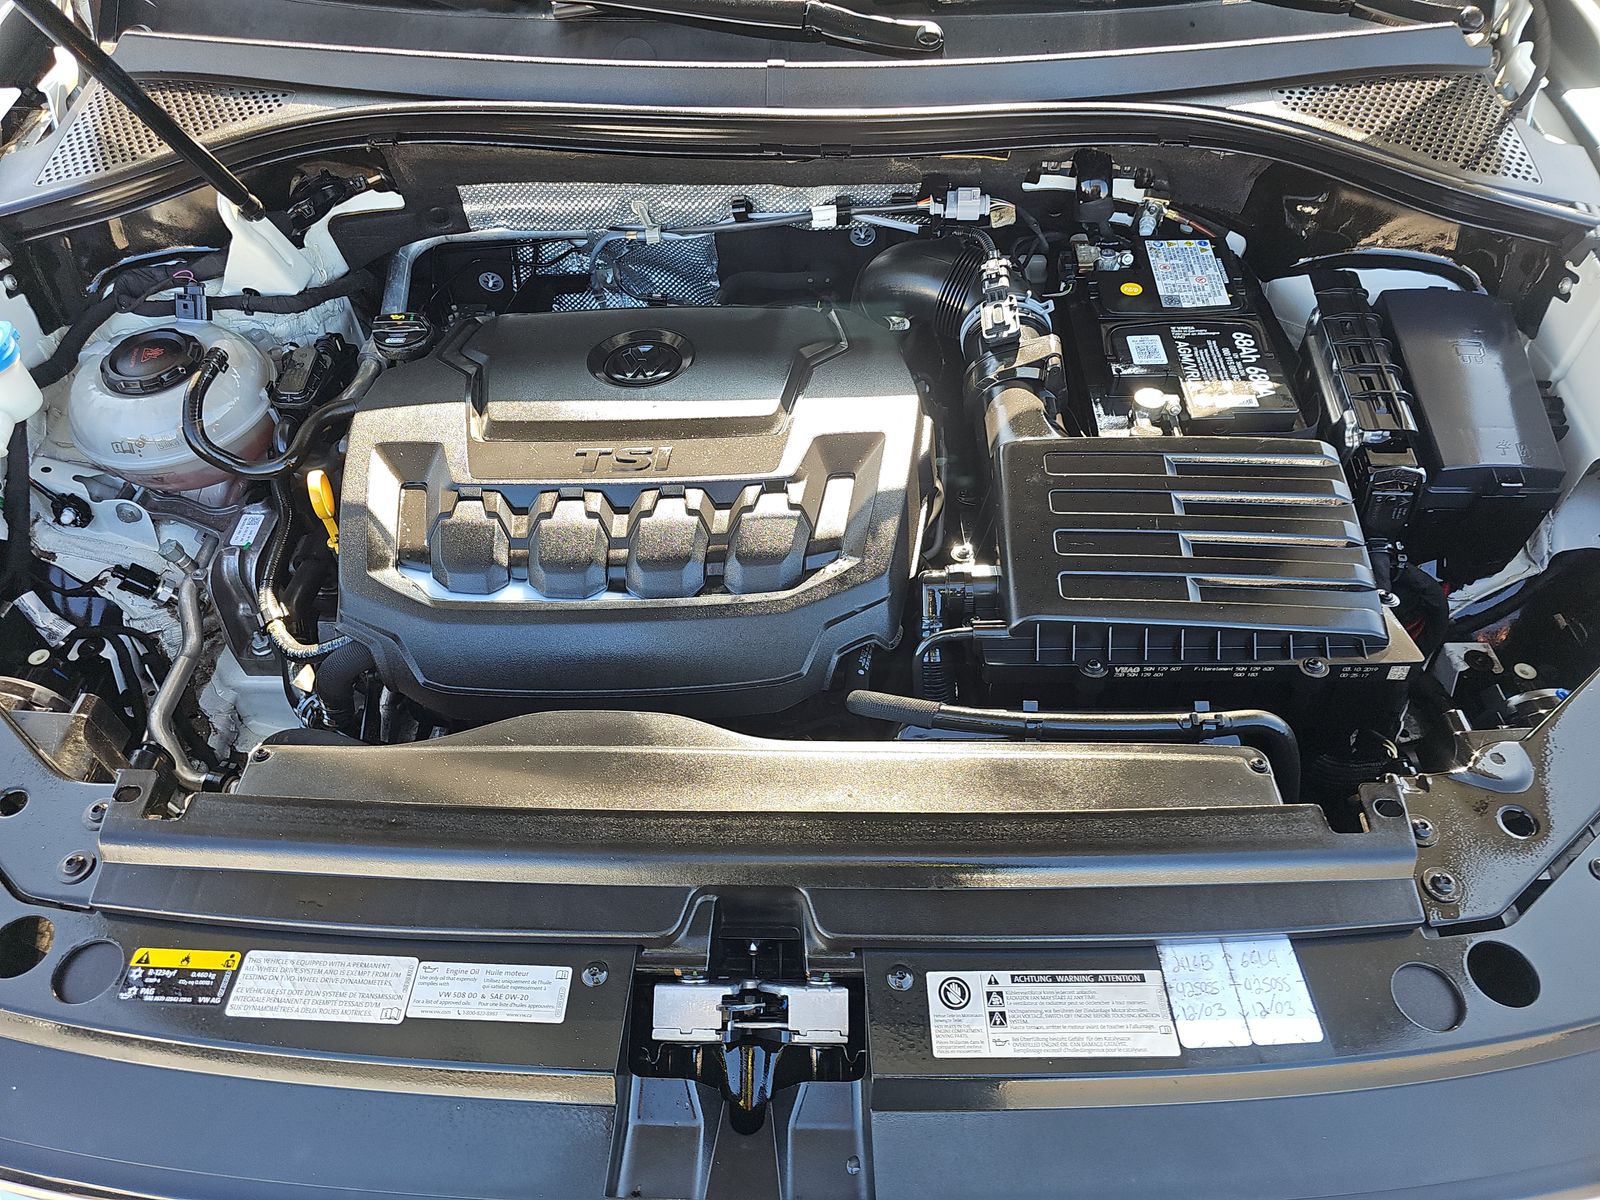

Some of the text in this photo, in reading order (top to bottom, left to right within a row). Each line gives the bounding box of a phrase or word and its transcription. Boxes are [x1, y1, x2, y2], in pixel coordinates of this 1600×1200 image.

[1231, 331, 1261, 363] 68Ah
[1174, 340, 1203, 385] AGM/VRL
[575, 445, 673, 473] TSI
[263, 957, 288, 965] VEHICLE
[296, 959, 328, 967] EQUIPPED
[328, 960, 346, 968] WITH
[352, 961, 391, 970] PERMANENT
[147, 968, 178, 978] R-1234yf
[445, 967, 469, 976] Engine
[1014, 974, 1141, 983] ACHTUNG WARNING ATTENTION
[452, 991, 467, 999] 508
[504, 993, 530, 1001] 0W-20
[1181, 1002, 1227, 1021] 12/03
